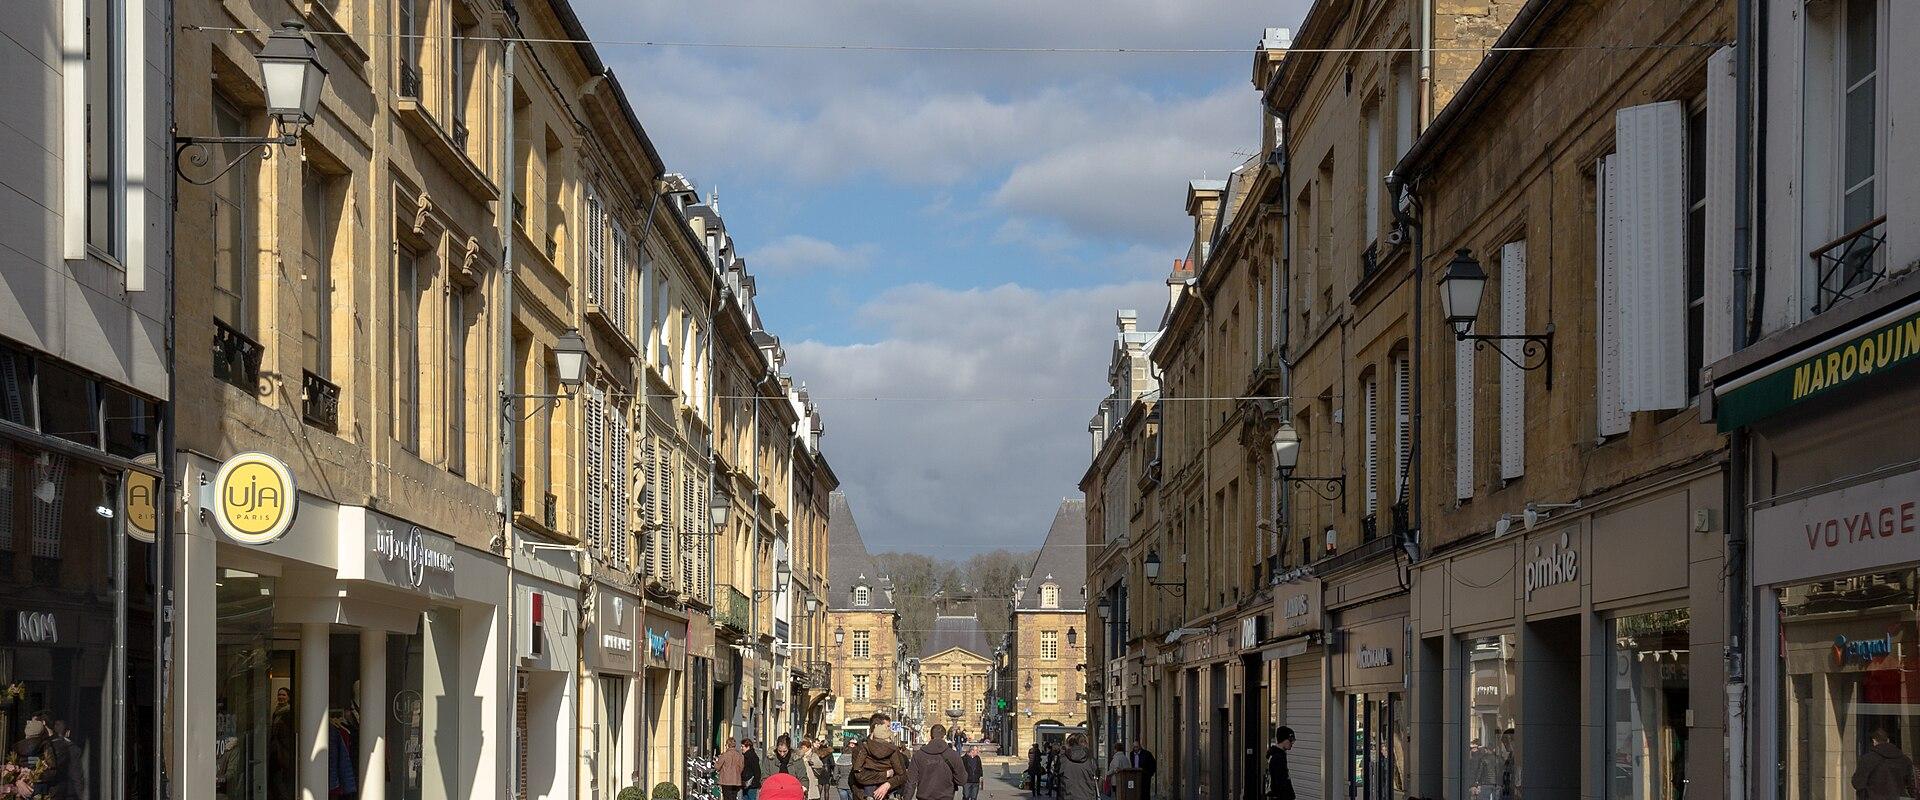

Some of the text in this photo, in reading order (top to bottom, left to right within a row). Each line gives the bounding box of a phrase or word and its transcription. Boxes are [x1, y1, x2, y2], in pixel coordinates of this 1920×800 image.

[1793, 318, 1920, 400] MAROQUIN
[236, 513, 270, 521] PARIS
[1805, 501, 1915, 550] VOYAGE
[1525, 532, 1577, 602] pimkie
